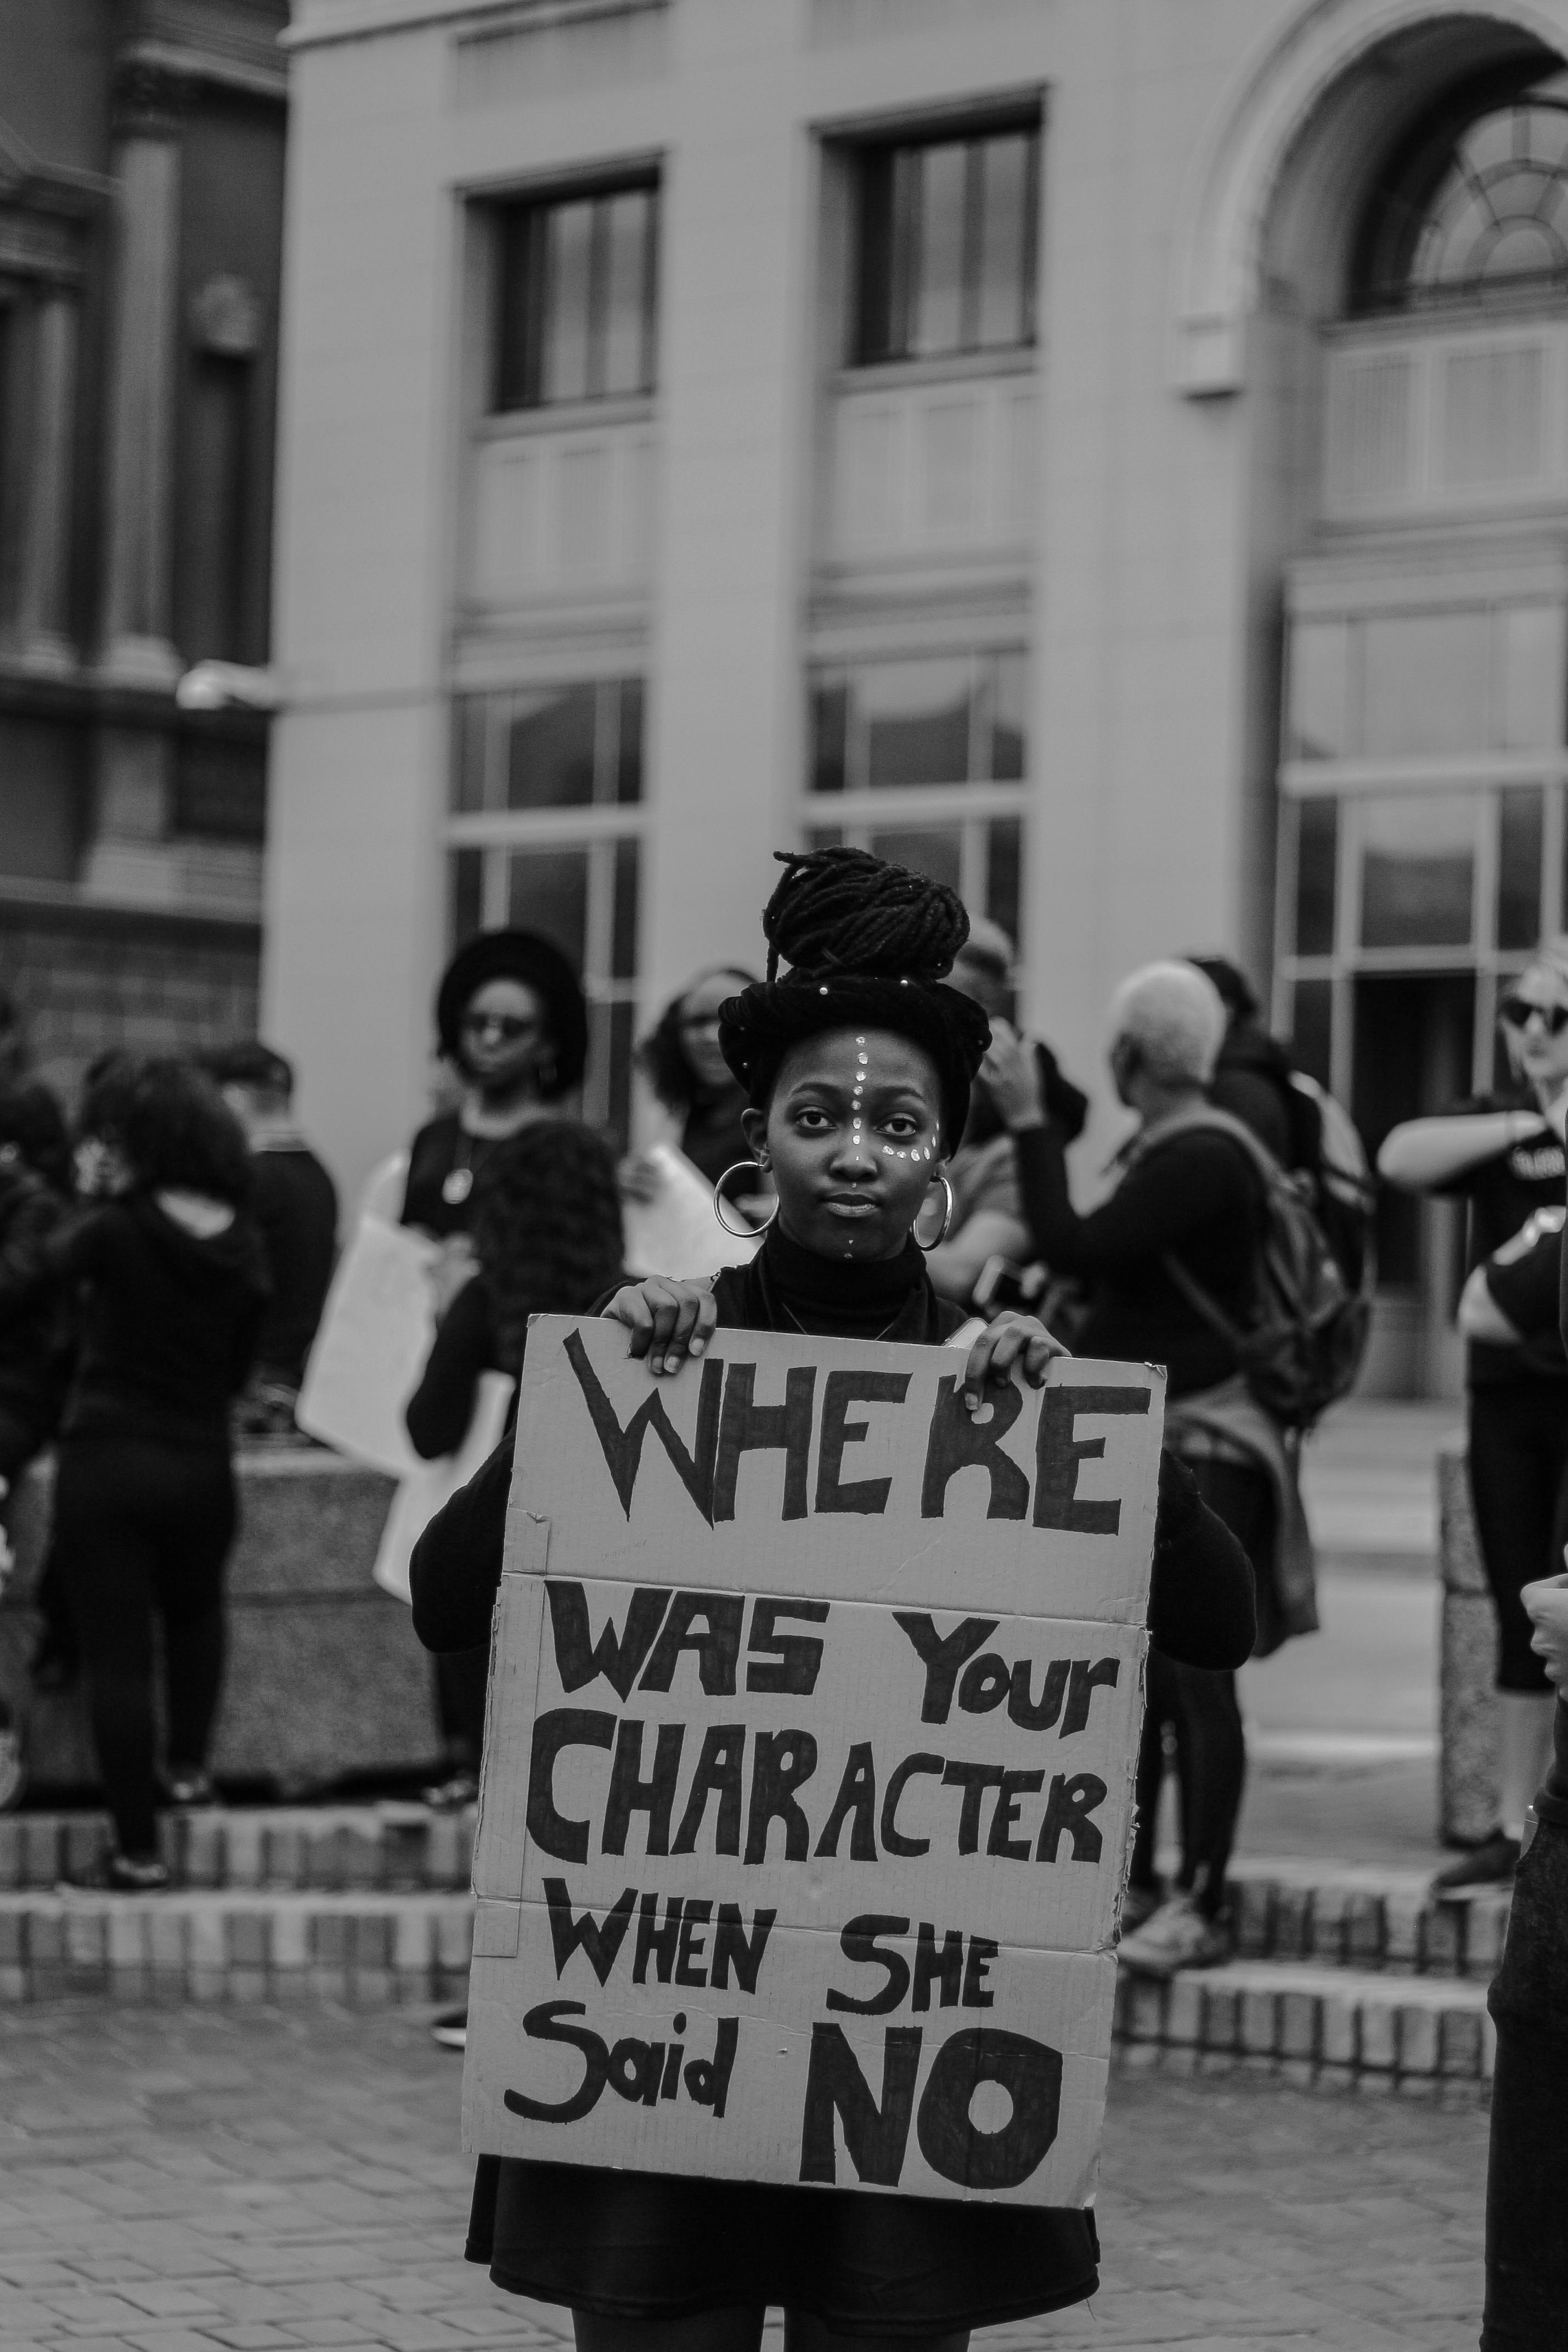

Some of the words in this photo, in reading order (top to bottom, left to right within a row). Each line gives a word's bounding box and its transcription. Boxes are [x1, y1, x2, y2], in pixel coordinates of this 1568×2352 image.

[563, 1328, 1151, 1536] WHERE
[544, 1580, 830, 1703] WAS
[893, 1612, 1120, 1739] Your
[526, 1708, 1107, 1865] CHARACTER
[542, 1878, 777, 1994] WHEN
[826, 1915, 999, 2016] SHE
[504, 2000, 739, 2125] Said
[799, 2022, 1063, 2190] NO
